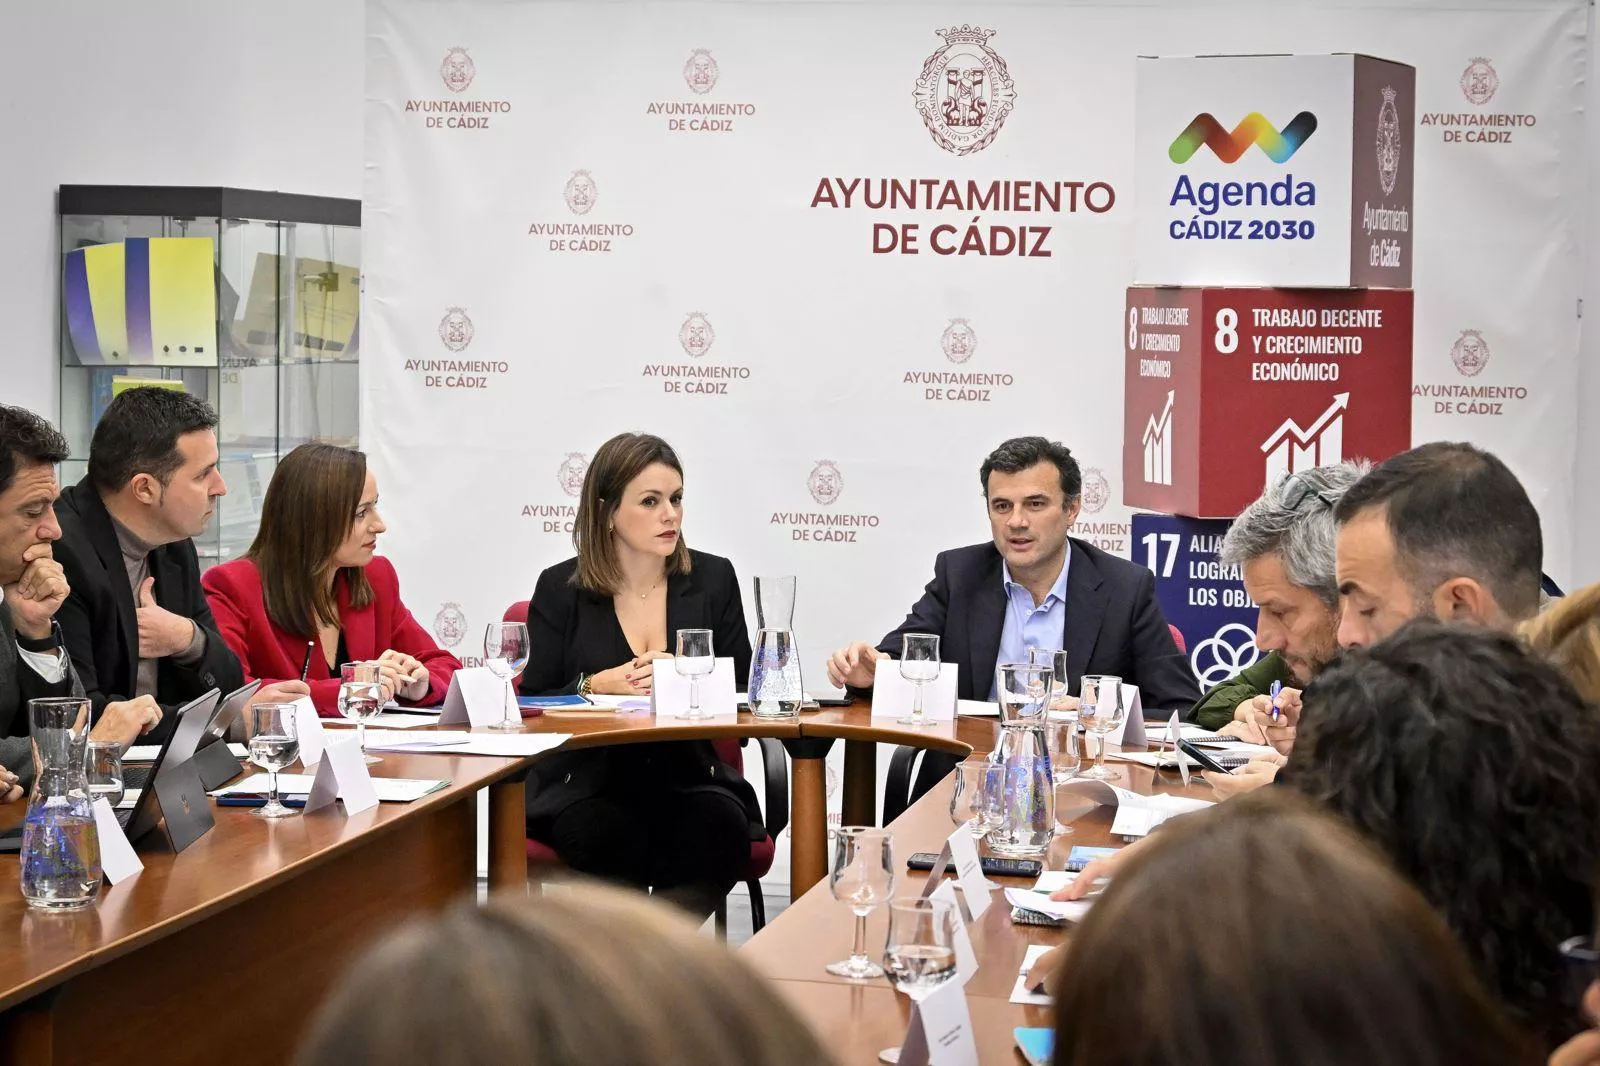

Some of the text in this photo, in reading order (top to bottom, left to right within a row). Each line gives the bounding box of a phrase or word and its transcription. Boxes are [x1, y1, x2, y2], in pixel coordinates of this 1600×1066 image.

[405, 100, 510, 113] AYUNTAMIENTO
[647, 103, 755, 116] AYUNTAMIENTO
[426, 115, 488, 128] DE CÁDIZ
[669, 117, 732, 131] DE CÁDIZ
[1421, 114, 1536, 127] AYUNTAMIENTO
[1444, 128, 1512, 143] DE CÁDIZ
[811, 178, 1115, 213] AYUNTAMIENTO
[1170, 174, 1315, 215] Agenda
[1363, 202, 1408, 235] Ayuntamiento
[529, 224, 633, 236] AYUNTAMIENTO
[1170, 214, 1314, 239] CÁDIZ 2030
[550, 237, 610, 251] DE CÁDIZ
[873, 216, 1052, 257] DE CÁDIZ
[1370, 239, 1400, 267] de Cádiz
[1142, 307, 1189, 326] TRABAJO DECENTE
[1252, 309, 1382, 327] TRABAJO DECENTE
[1129, 306, 1138, 350] 8
[1215, 308, 1238, 353] 8
[1141, 333, 1180, 352] Y CRECIMIENTO
[1253, 336, 1362, 354] Y CRECIMIENTO
[405, 359, 508, 372] AYUNTAMIENTO
[643, 365, 750, 378] AYUNTAMIENTO
[1140, 354, 1171, 378] ECONÓMICO
[1253, 358, 1339, 381] ECONÓMICO
[426, 374, 486, 388] DE CÁDIZ
[904, 372, 1013, 385] AYUNTAMIENTO
[665, 380, 727, 394] DE CÁDIZ
[926, 386, 990, 401] DE CÁDIZ
[1413, 385, 1527, 399] AYUNTAMIENTO
[1435, 400, 1502, 415] DE CÁDIZ
[521, 505, 576, 517] AYUNTA
[543, 521, 560, 533] DE
[771, 513, 879, 526] AYUNTAMIENTO
[793, 527, 856, 542] DE CÁDIZ
[1189, 535, 1223, 553] ALIA
[1142, 532, 1180, 577] 17
[1189, 561, 1243, 580] LOGRA
[1189, 588, 1217, 606] LOS
